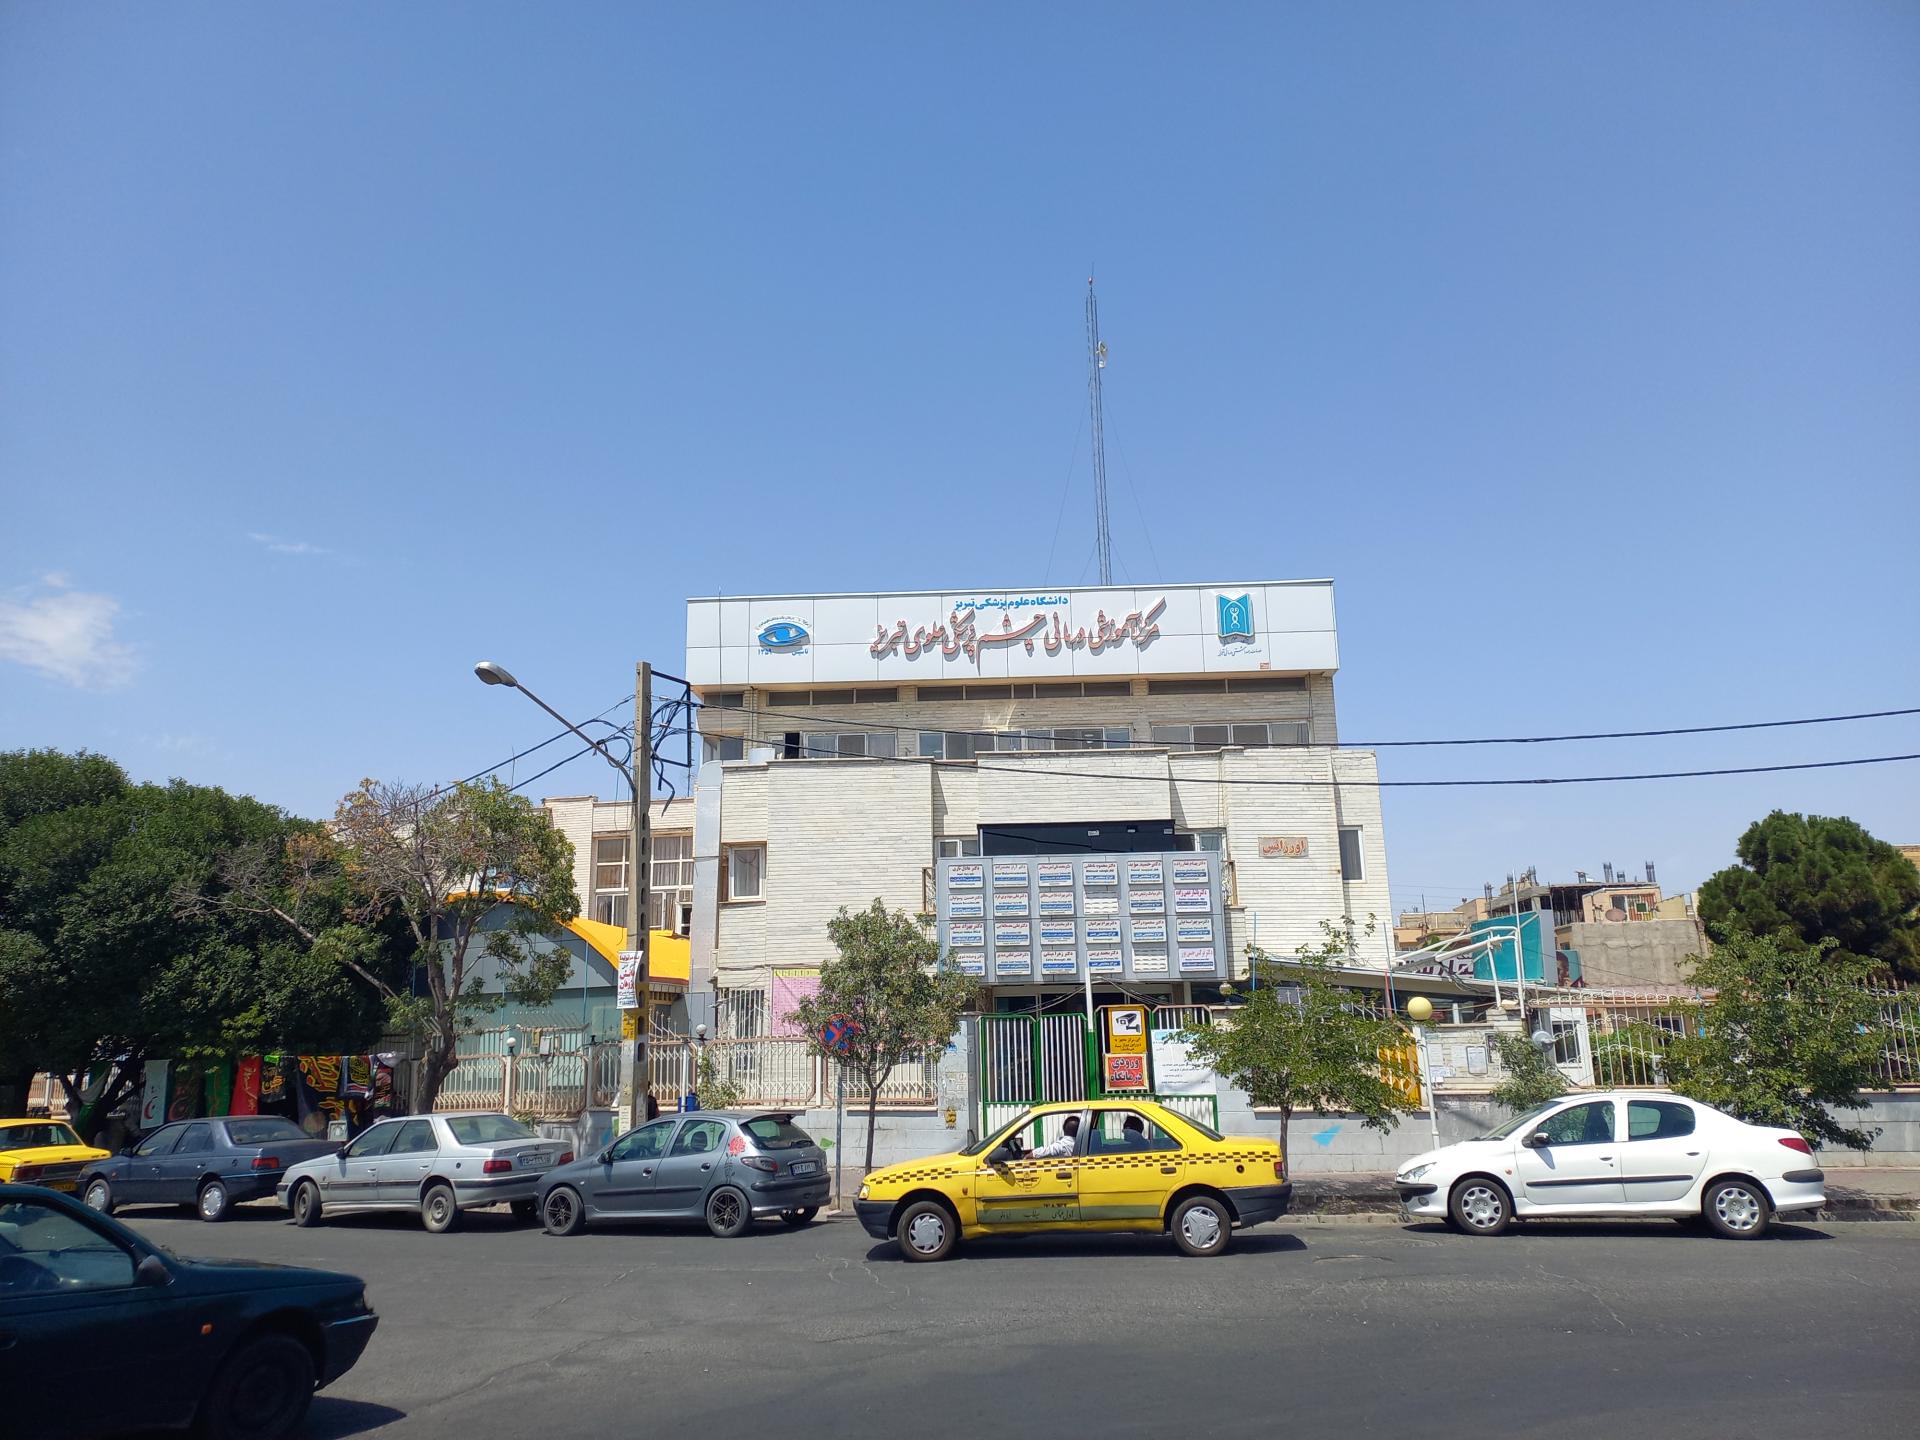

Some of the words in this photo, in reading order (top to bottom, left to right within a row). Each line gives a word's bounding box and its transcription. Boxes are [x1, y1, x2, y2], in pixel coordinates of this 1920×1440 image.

[954, 598, 976, 611] تبریز
[975, 598, 1007, 611] پزشکی
[1007, 597, 1030, 609] علوم
[1030, 594, 1069, 606] دانشگاه
[1112, 1058, 1139, 1070] ورودی
[1110, 1071, 1143, 1084] درمانگاه
